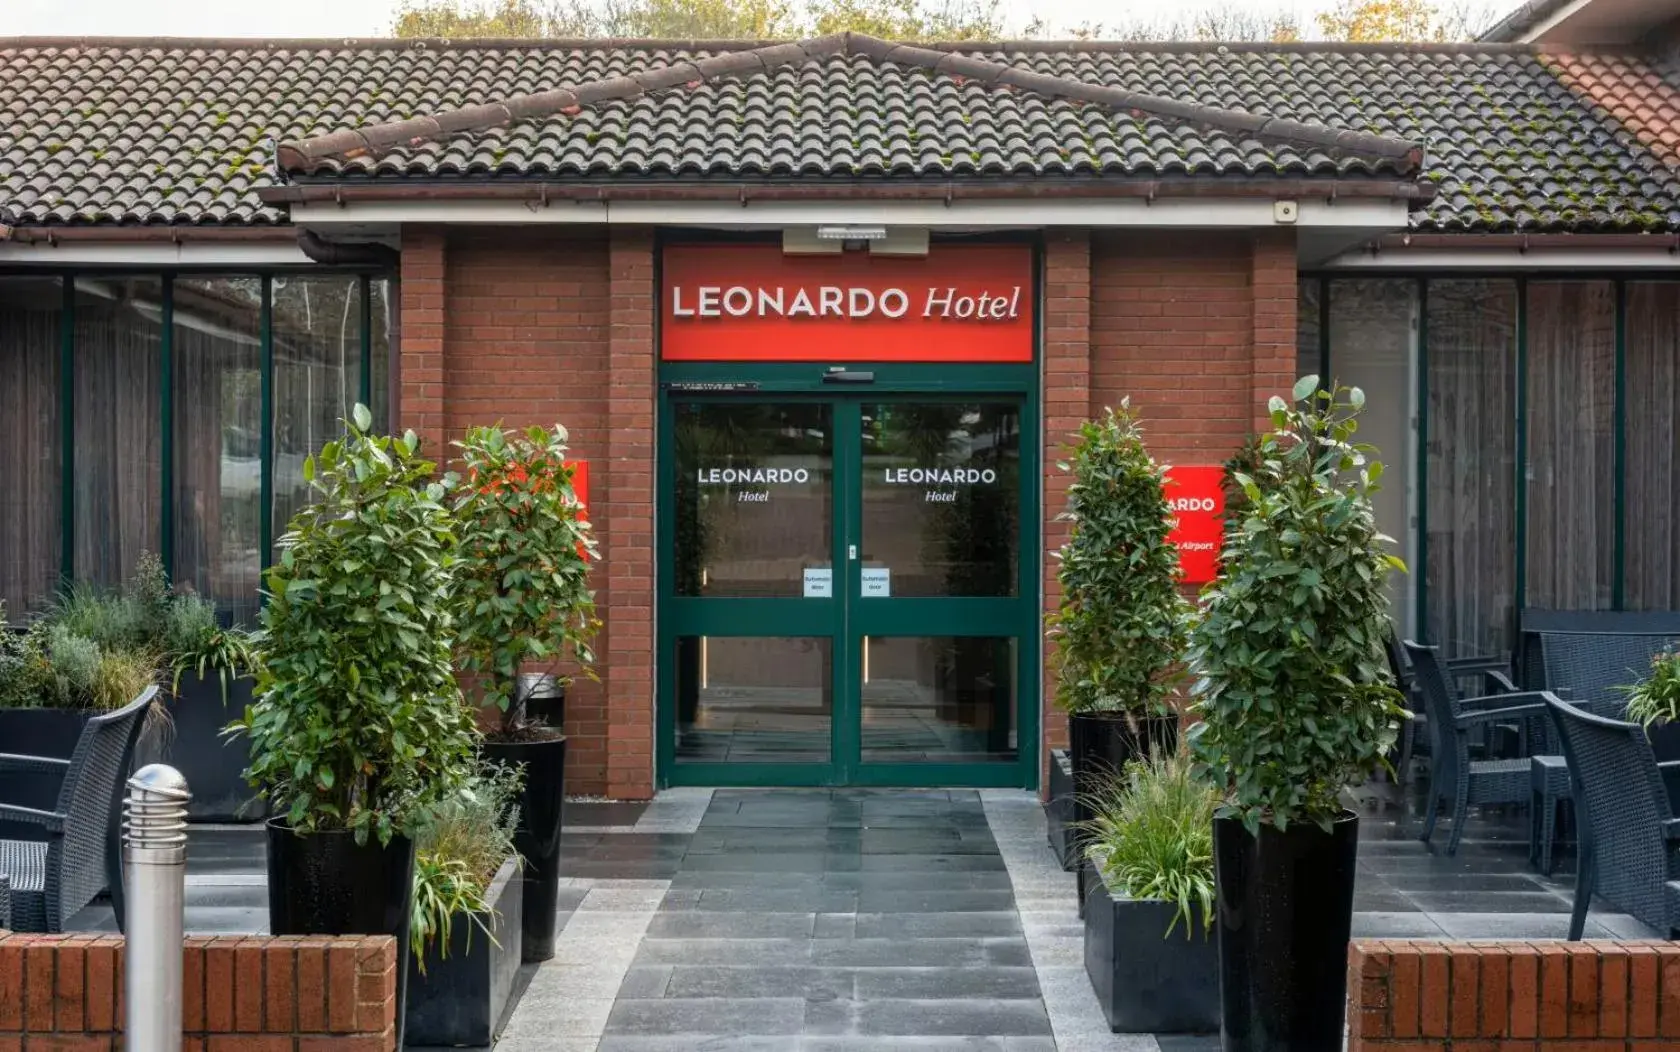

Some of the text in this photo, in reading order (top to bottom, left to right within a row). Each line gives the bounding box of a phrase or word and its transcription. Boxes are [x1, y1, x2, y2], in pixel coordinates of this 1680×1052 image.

[673, 286, 1021, 319] LEONARDO Hotel
[698, 468, 809, 484] LEONARDO
[885, 468, 996, 484] LEONARDO
[738, 490, 769, 502] Hotel
[925, 490, 956, 502] Hotel
[1167, 498, 1215, 511] ARDO
[1181, 542, 1213, 551] Airport
